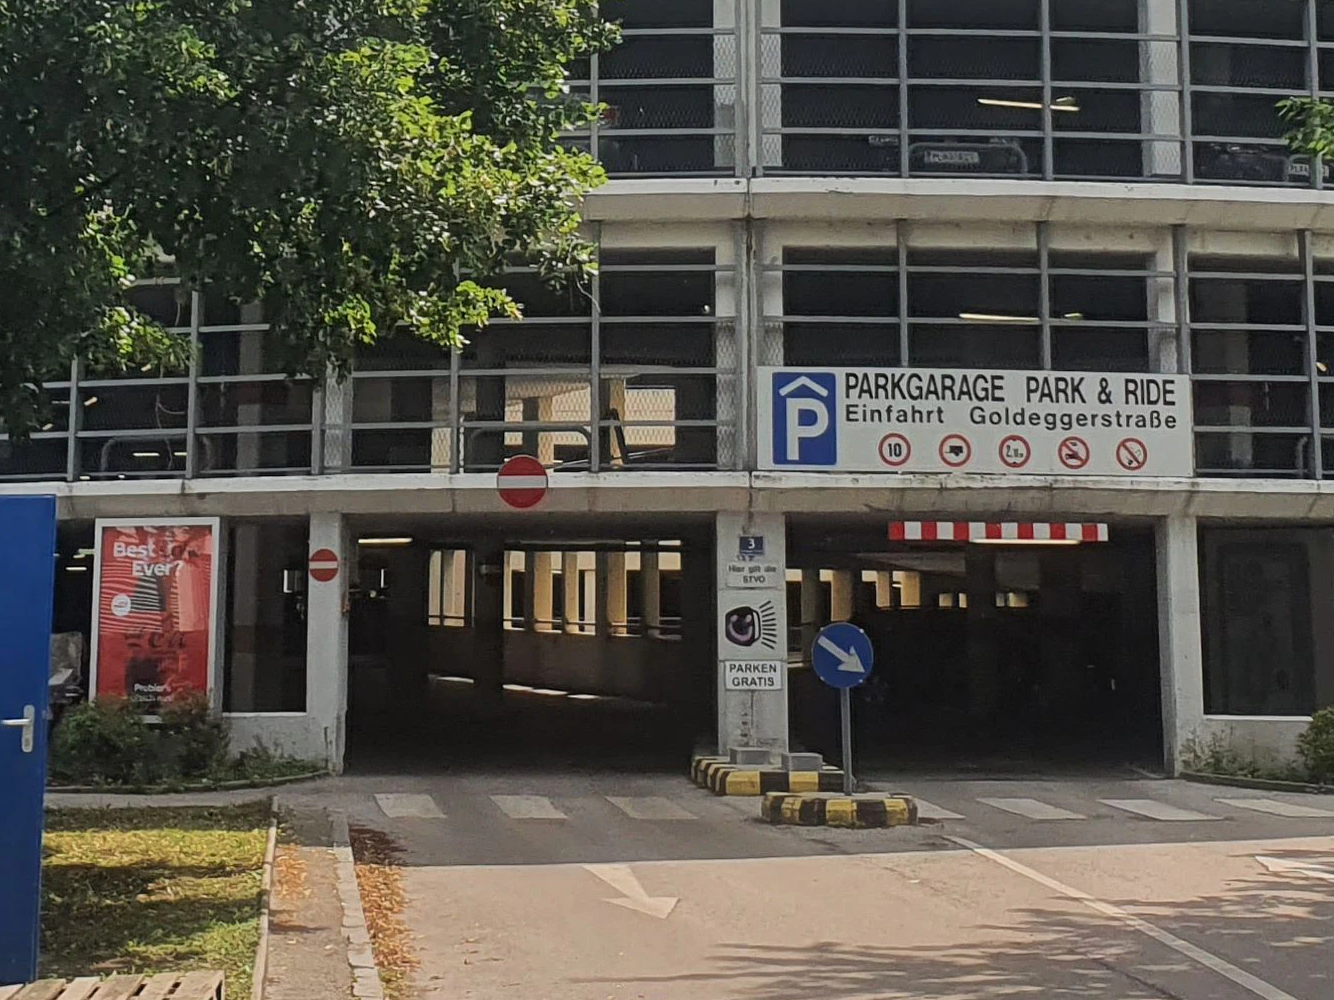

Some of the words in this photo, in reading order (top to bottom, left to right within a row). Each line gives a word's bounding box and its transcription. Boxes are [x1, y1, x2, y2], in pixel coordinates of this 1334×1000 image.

[845, 372, 1005, 402] PARKGARAGE
[1026, 376, 1087, 404] PARK
[1098, 377, 1113, 404] &
[1125, 378, 1176, 406] RIDE
[845, 404, 945, 423] Einfahrt
[970, 406, 1177, 431] Goldeggerstraße
[786, 397, 829, 461] P
[888, 443, 902, 457] 10
[113, 539, 156, 558] Best
[748, 538, 755, 549] 3
[132, 560, 184, 577] Ever?
[729, 663, 777, 673] PARKEN
[732, 677, 775, 687] GRATIS
